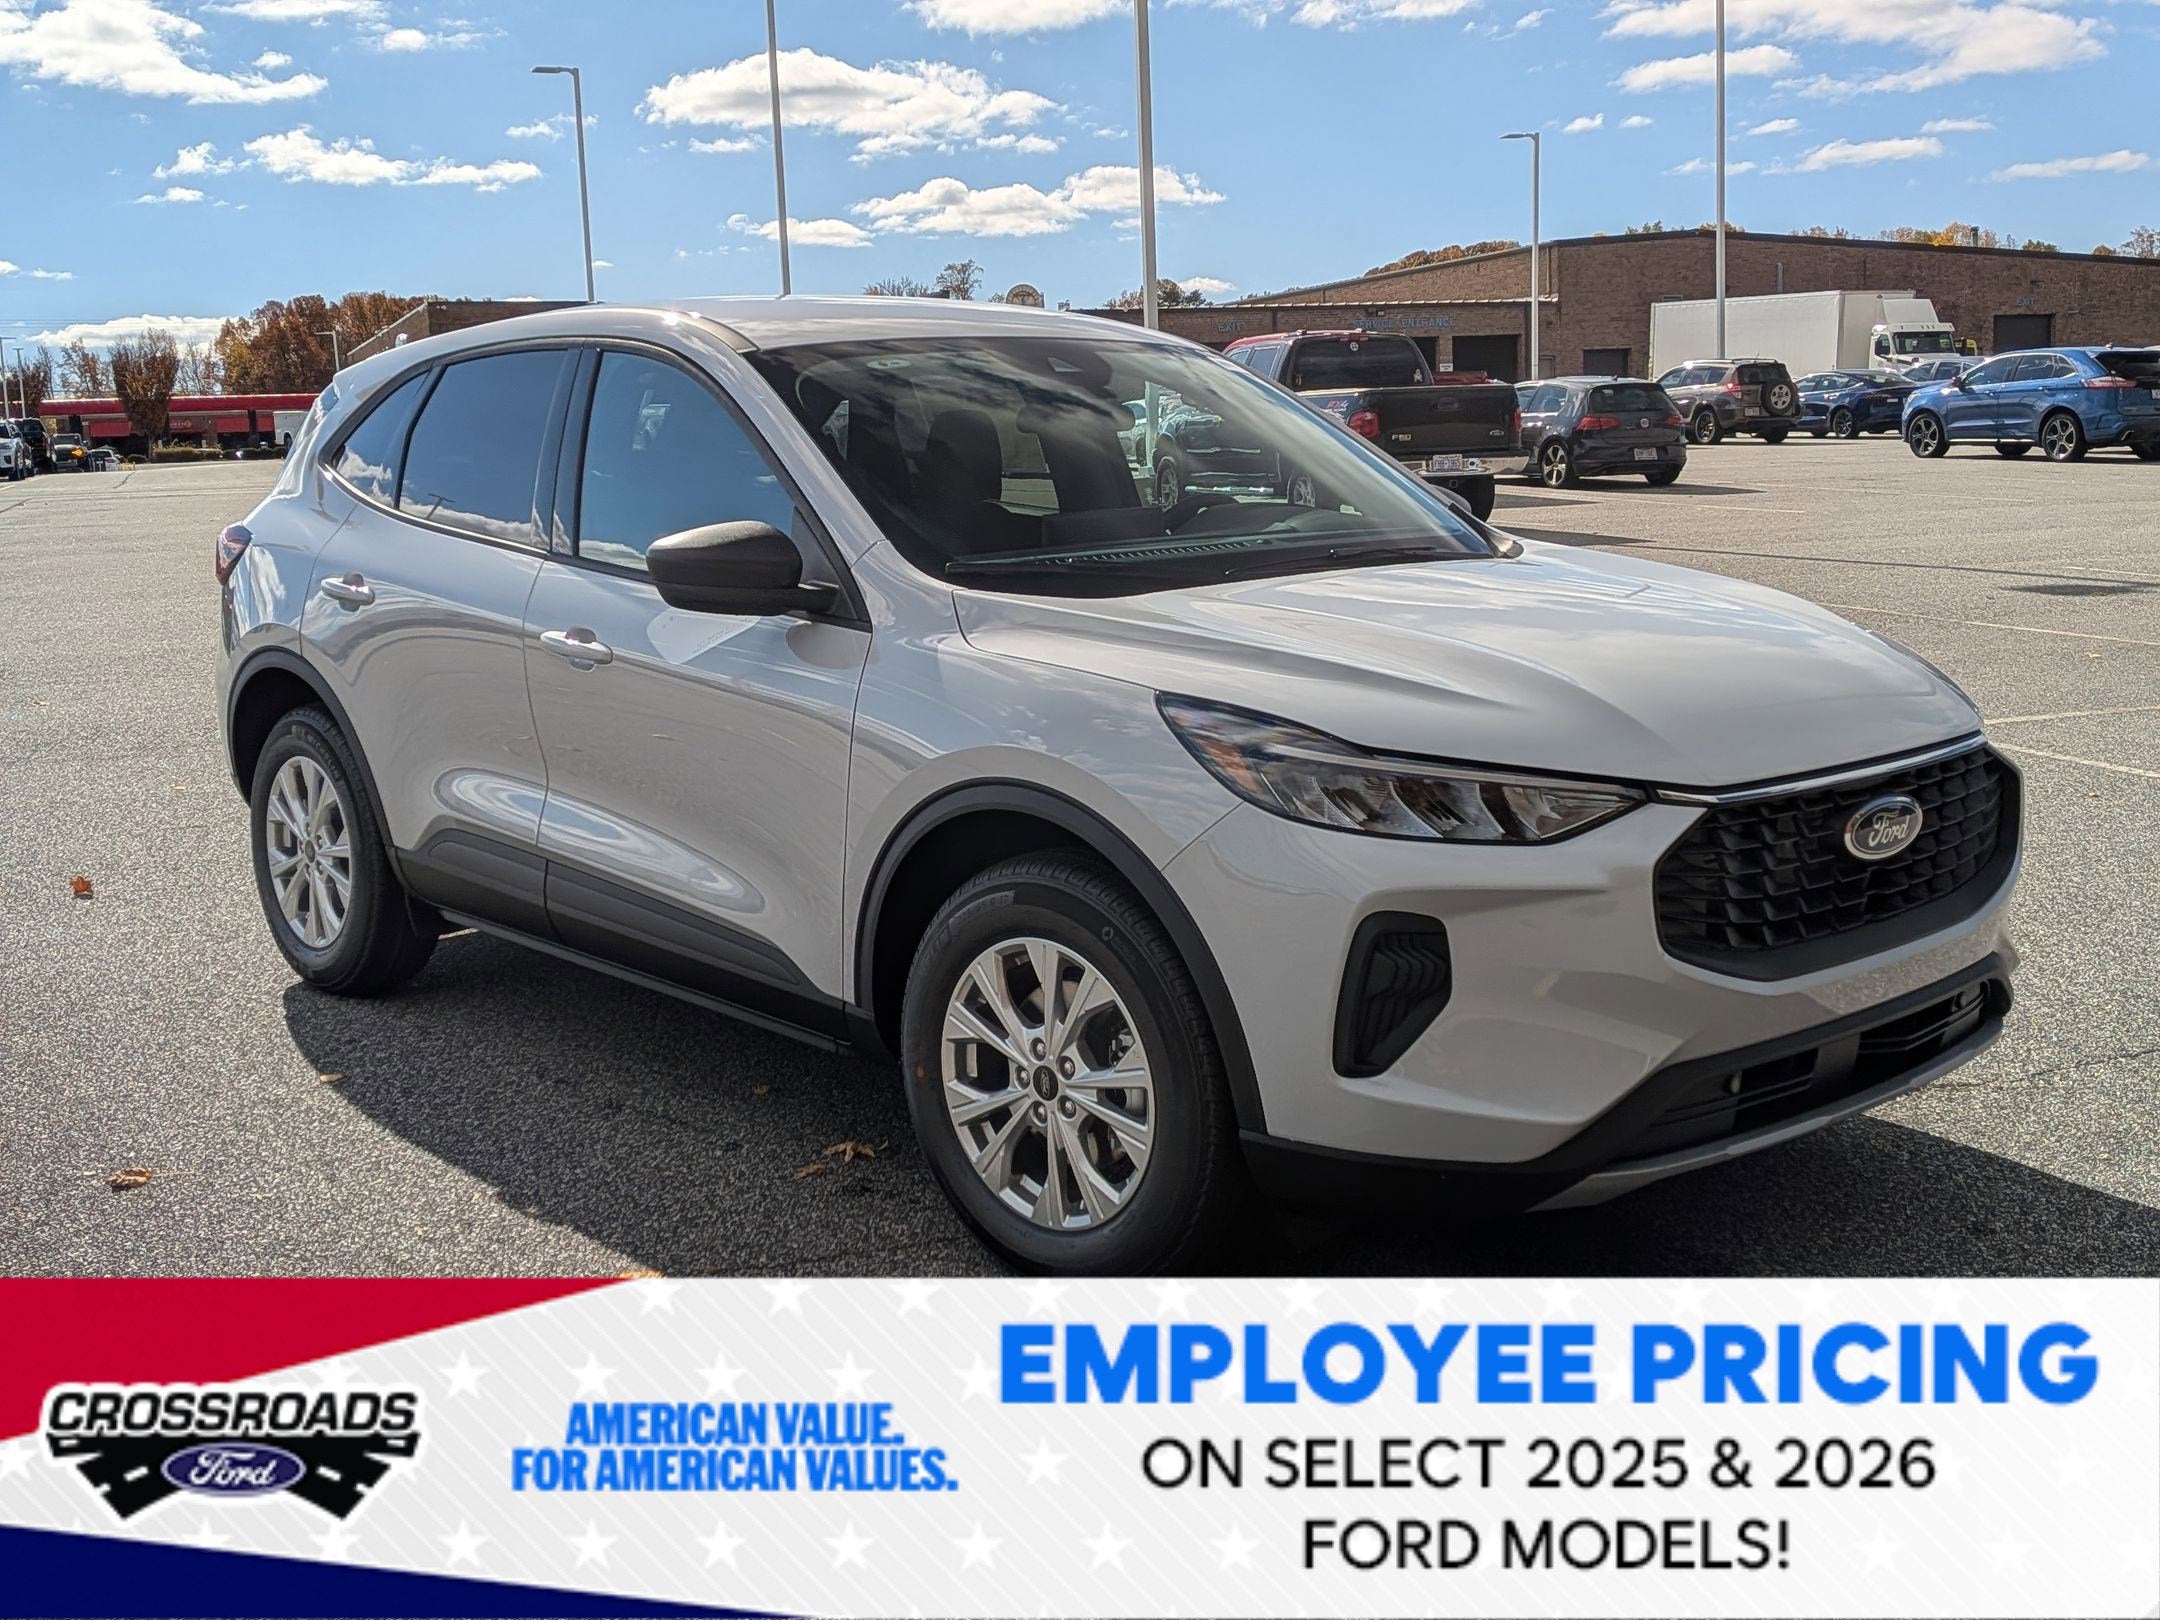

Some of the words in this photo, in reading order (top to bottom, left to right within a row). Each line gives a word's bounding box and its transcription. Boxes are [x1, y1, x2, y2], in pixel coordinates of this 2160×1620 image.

[1217, 320, 1242, 333] EXIT
[1401, 316, 1456, 328] ENTRANCE
[1867, 810, 1911, 848] Ford
